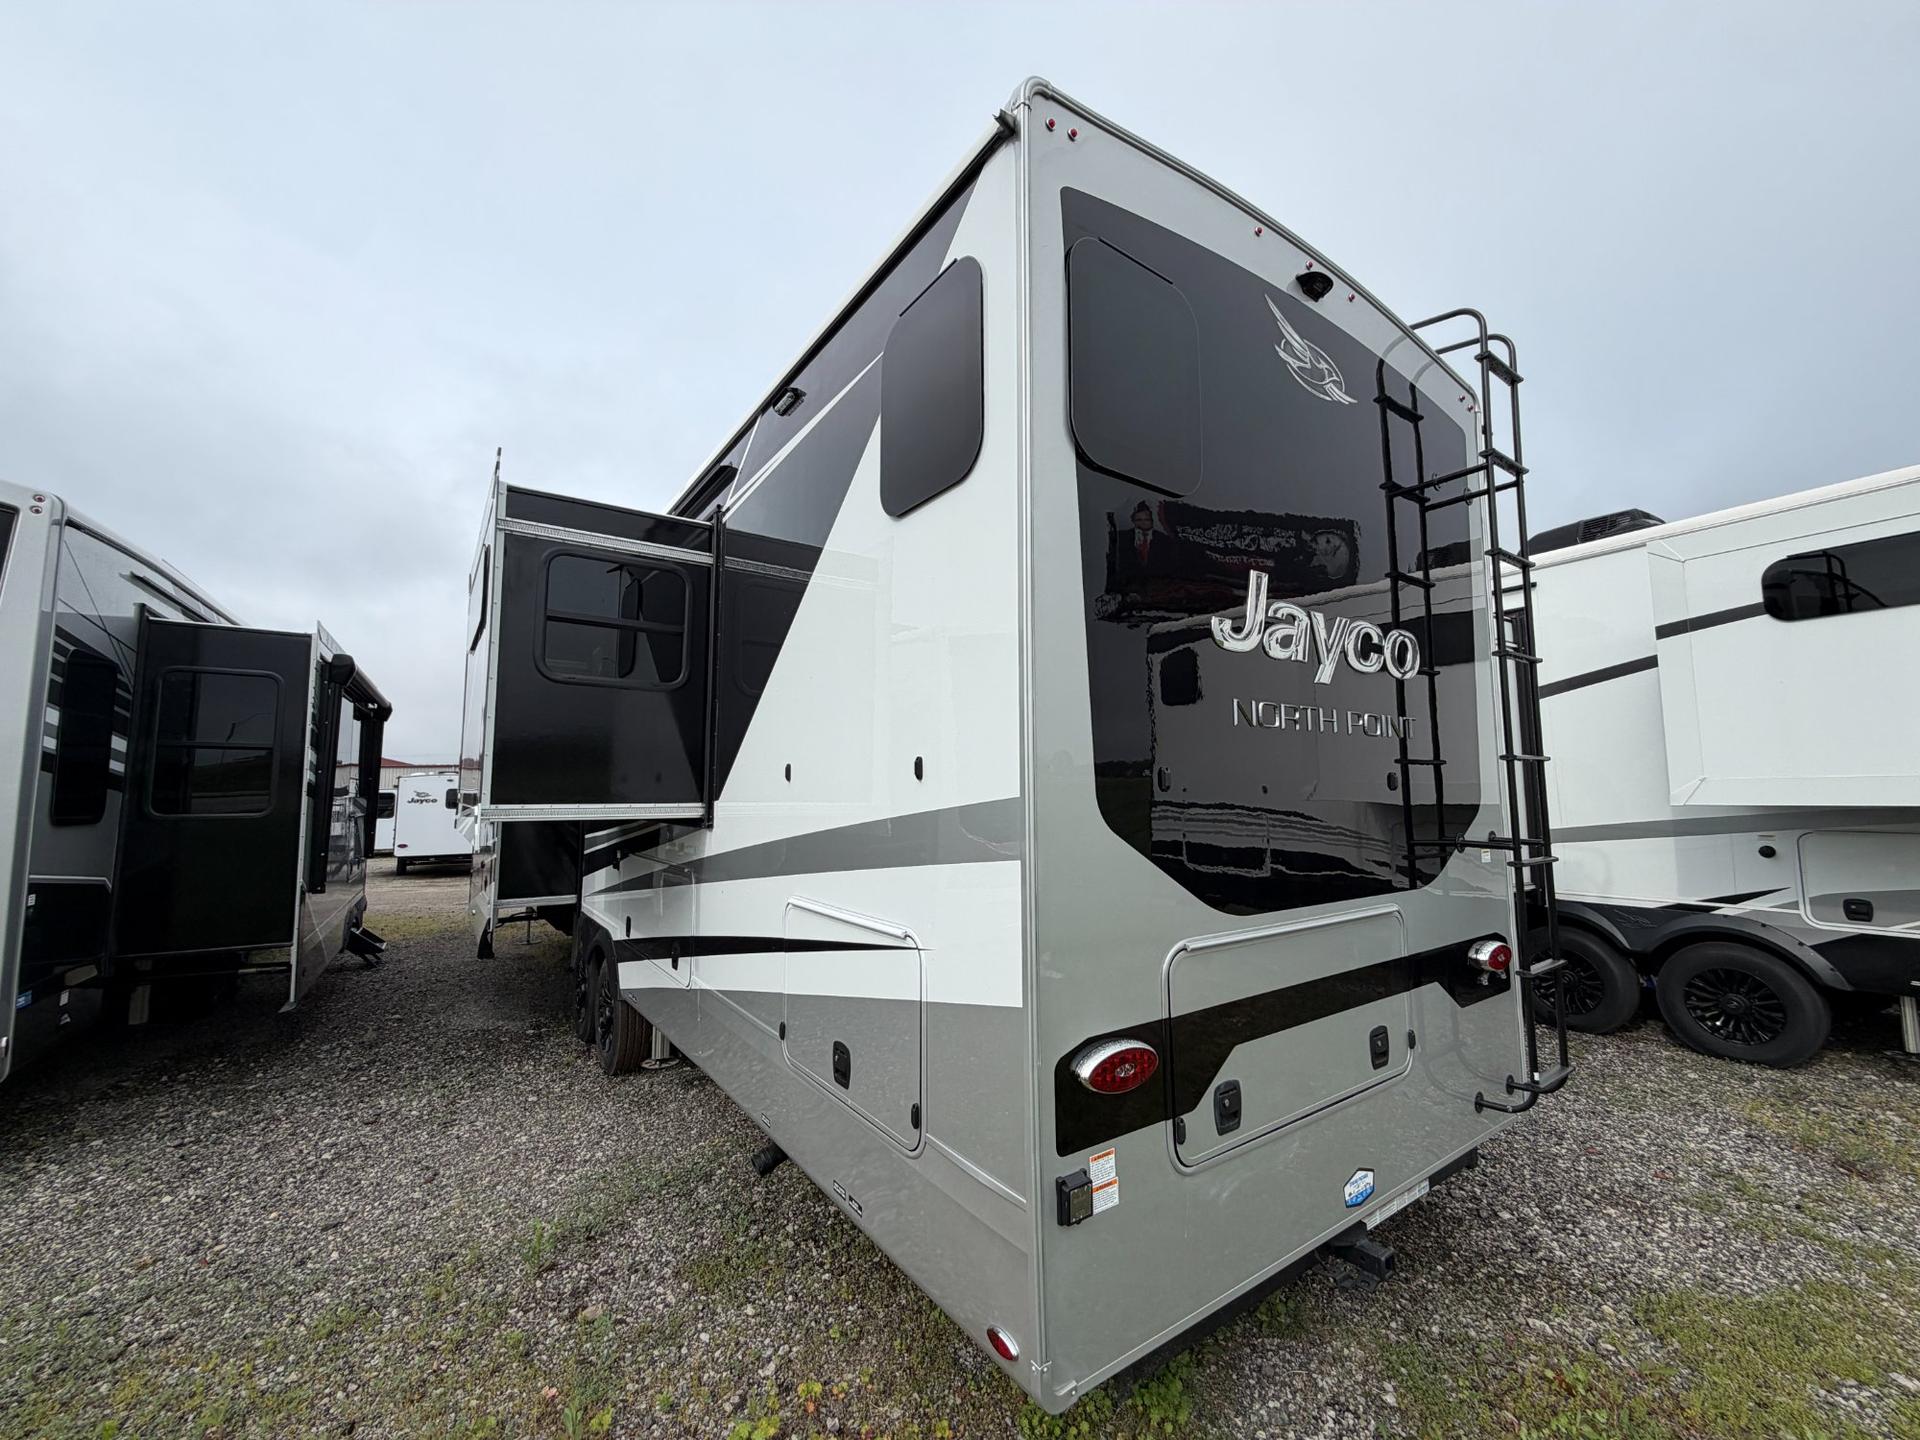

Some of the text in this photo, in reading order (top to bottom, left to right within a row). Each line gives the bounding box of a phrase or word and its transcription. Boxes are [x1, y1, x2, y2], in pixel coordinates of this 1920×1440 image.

[1211, 569, 1420, 685] Jayco
[1232, 698, 1417, 740] NORTH POINT
[407, 797, 438, 805] Jayco
